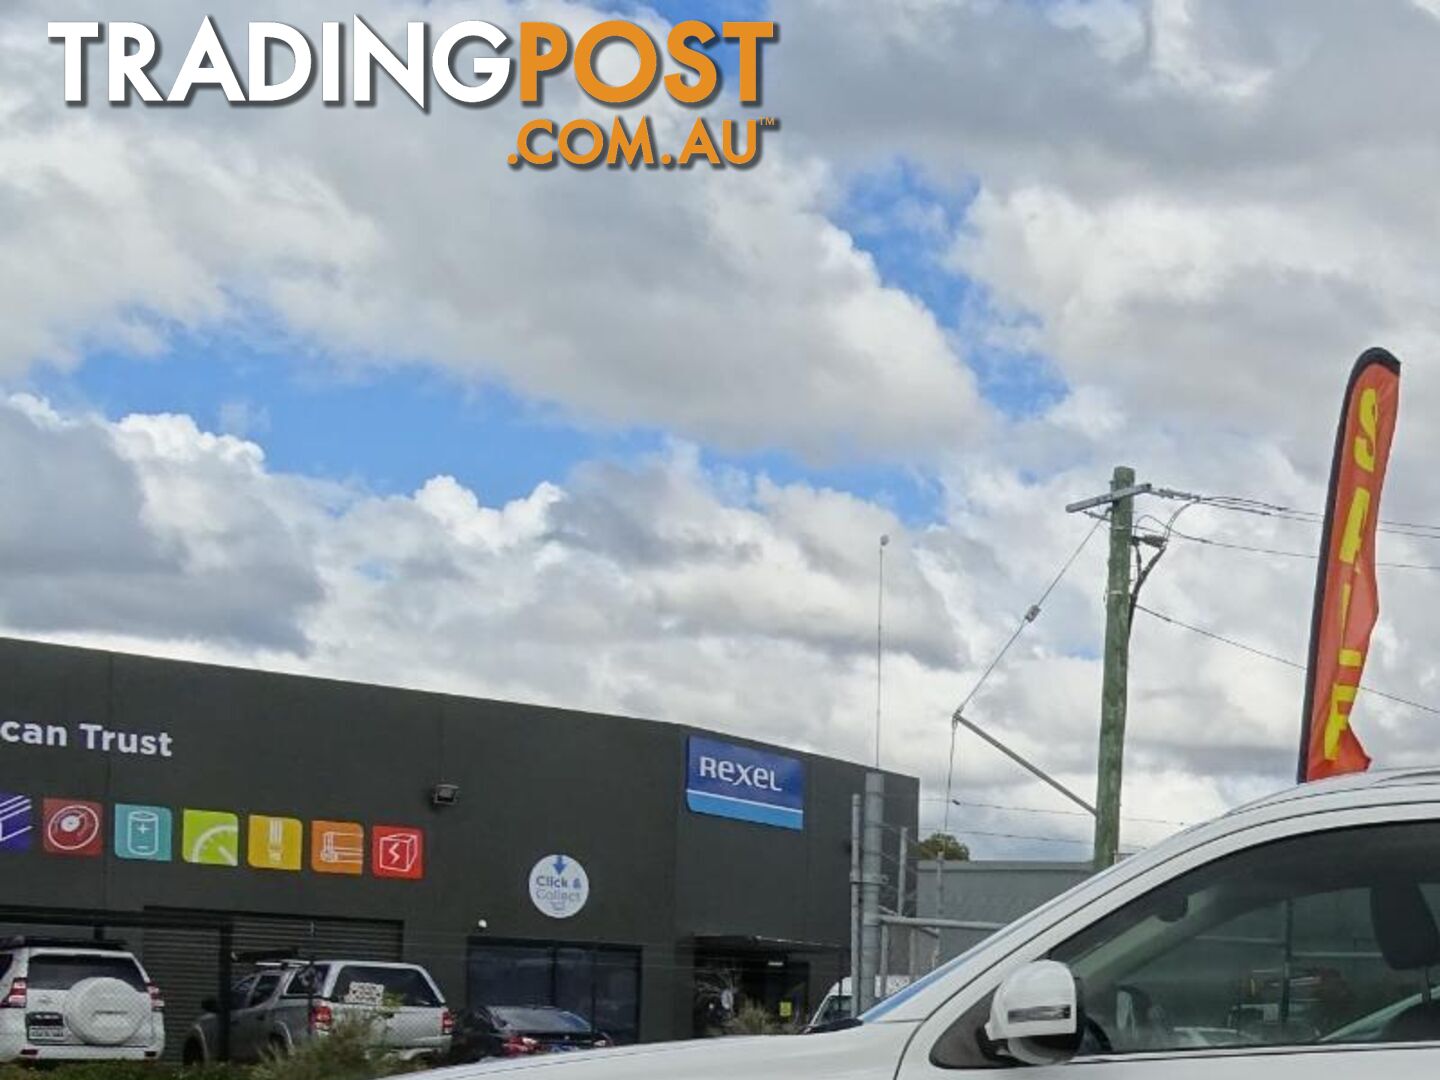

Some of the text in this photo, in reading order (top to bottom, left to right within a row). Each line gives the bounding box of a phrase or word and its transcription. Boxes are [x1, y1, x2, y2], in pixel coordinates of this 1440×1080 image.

[0, 720, 173, 757] can Trust
[536, 875, 568, 889] Click
